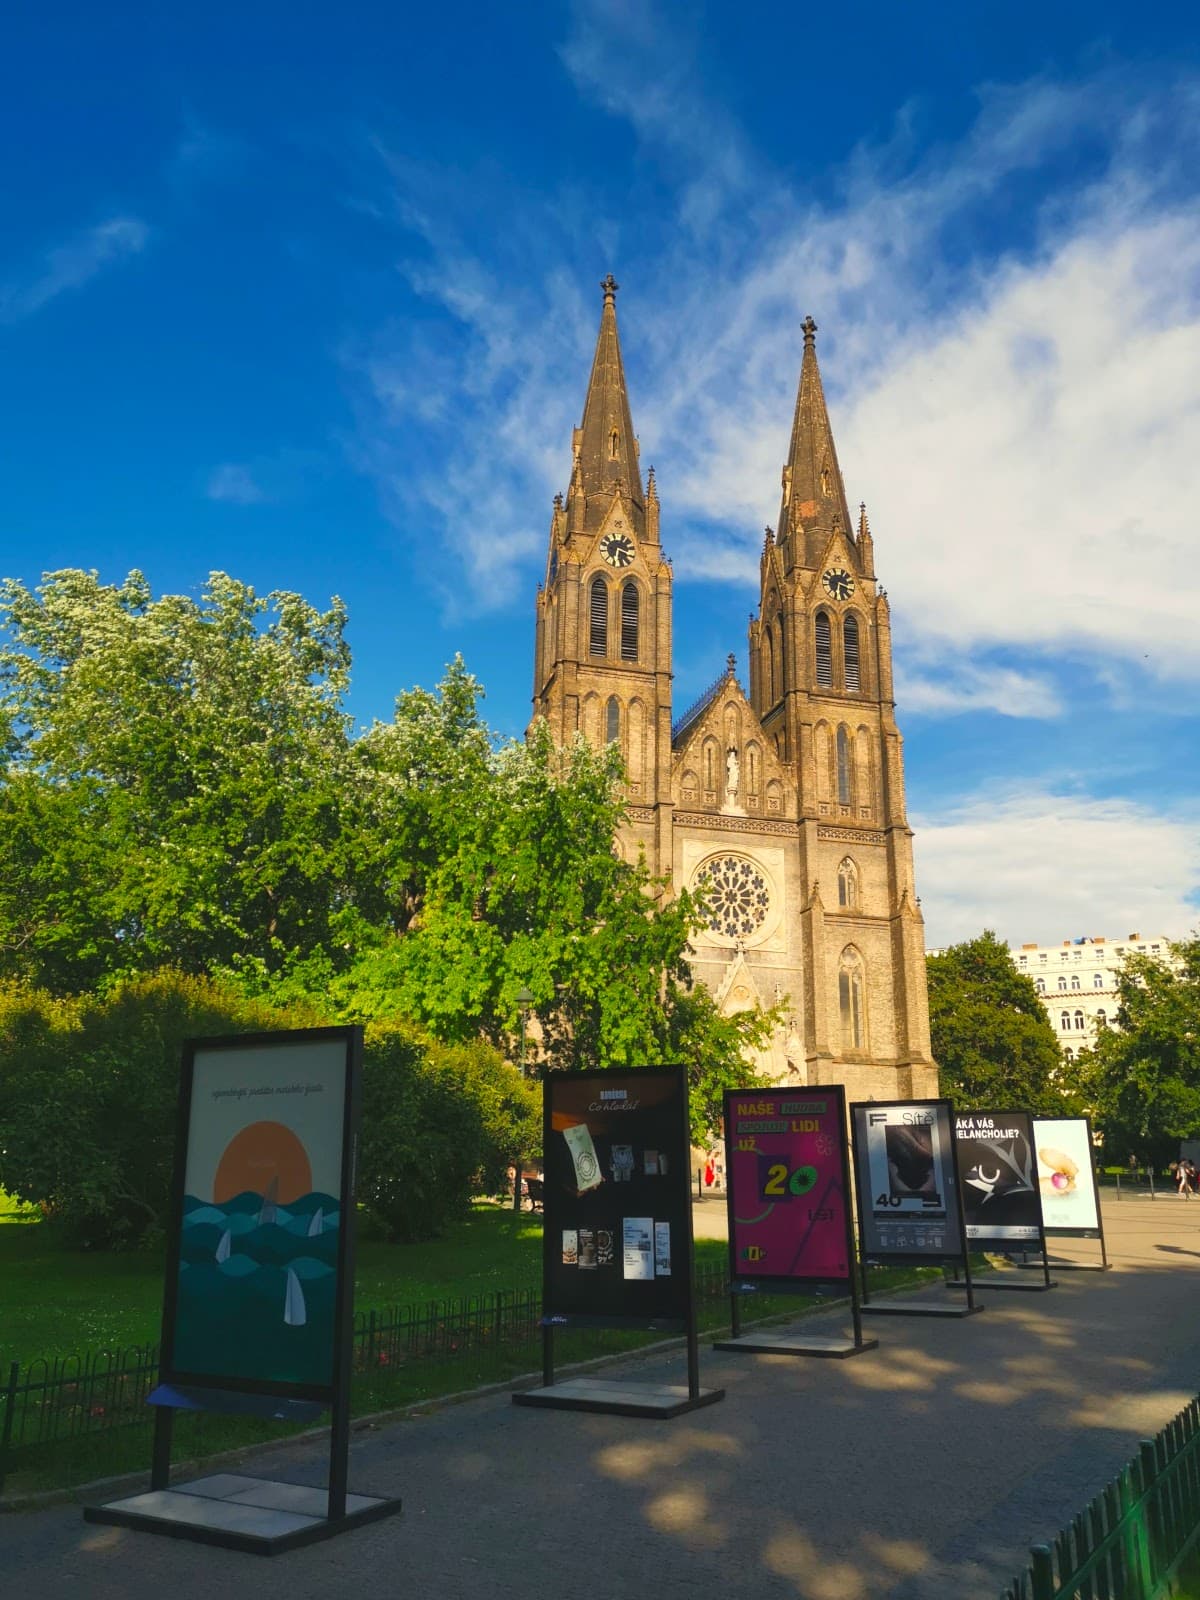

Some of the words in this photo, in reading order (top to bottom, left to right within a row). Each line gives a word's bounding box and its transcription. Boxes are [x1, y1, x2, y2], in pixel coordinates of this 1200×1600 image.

[737, 1100, 775, 1116] NAŠE
[792, 1120, 819, 1132] LIDI
[902, 1111, 934, 1126] Sítě
[956, 1117, 974, 1128] ÁKÁ
[976, 1117, 994, 1128] VÁS
[738, 1136, 756, 1151] UŽ
